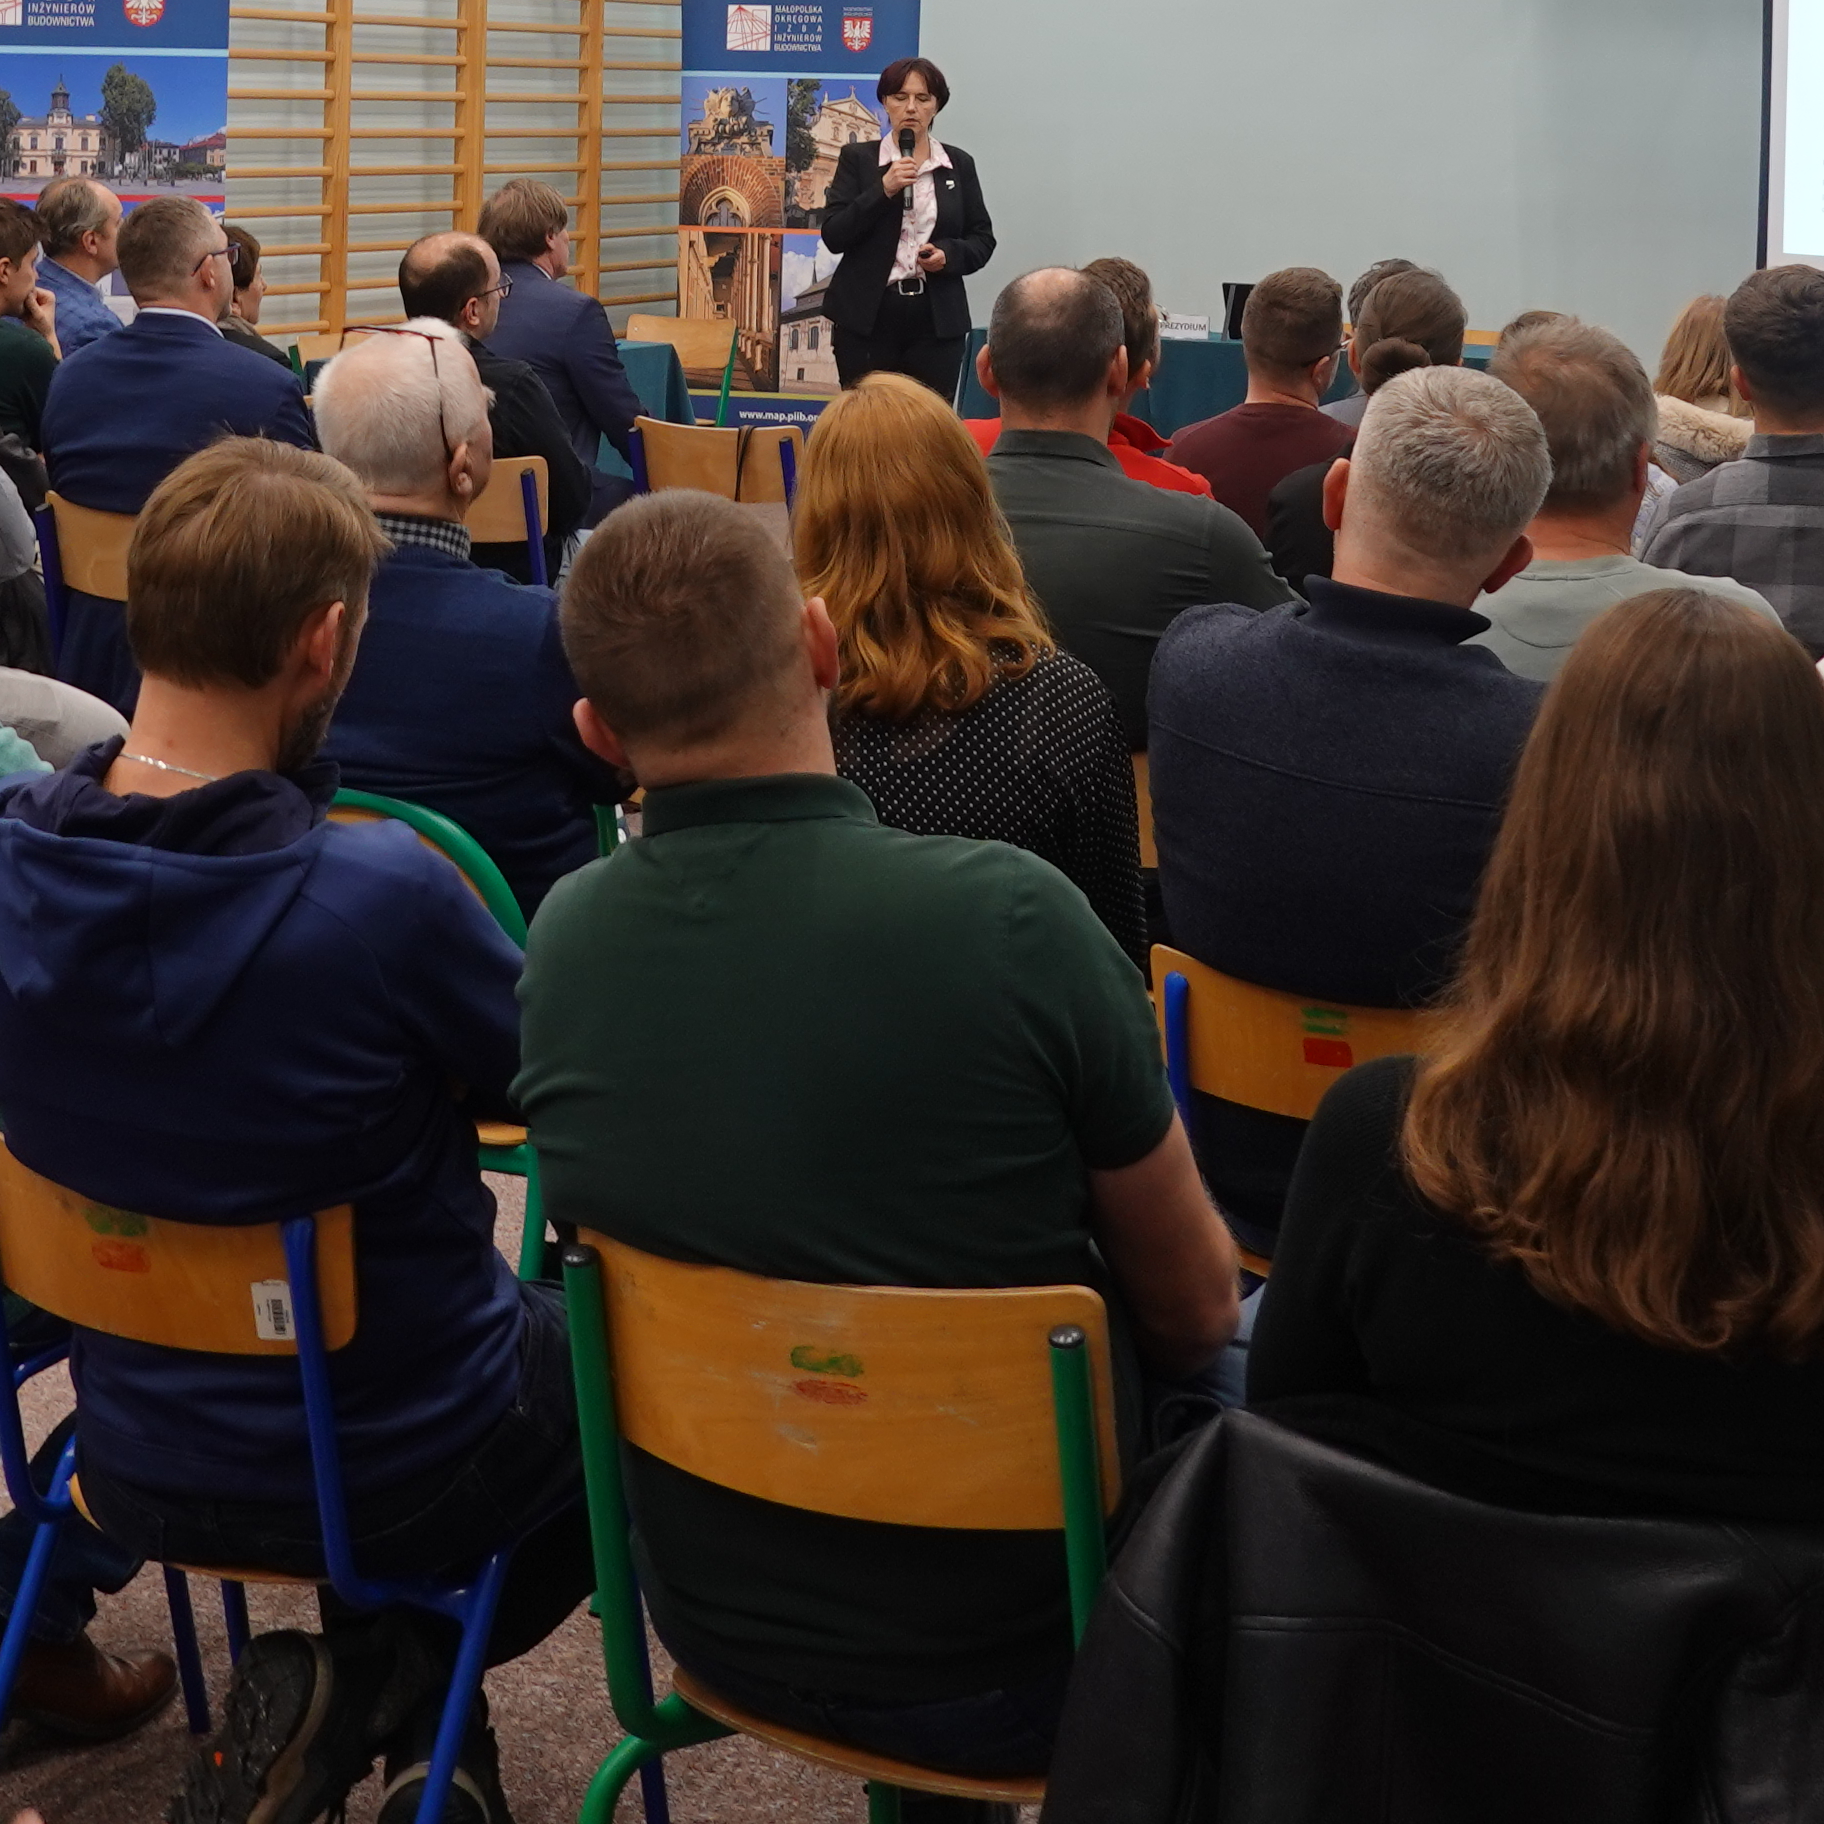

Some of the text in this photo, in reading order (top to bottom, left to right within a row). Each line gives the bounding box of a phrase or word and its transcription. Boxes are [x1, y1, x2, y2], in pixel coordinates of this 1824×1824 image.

[28, 2, 95, 14] INŻYNIERÓW
[775, 5, 823, 14] MAŁOPOLSKA
[27, 16, 95, 27] BUDOWNICTWA
[774, 15, 823, 24] OKRĘGOWA
[774, 33, 822, 42] INŻYNIERÓW
[739, 410, 819, 423] www.map.piib.or
